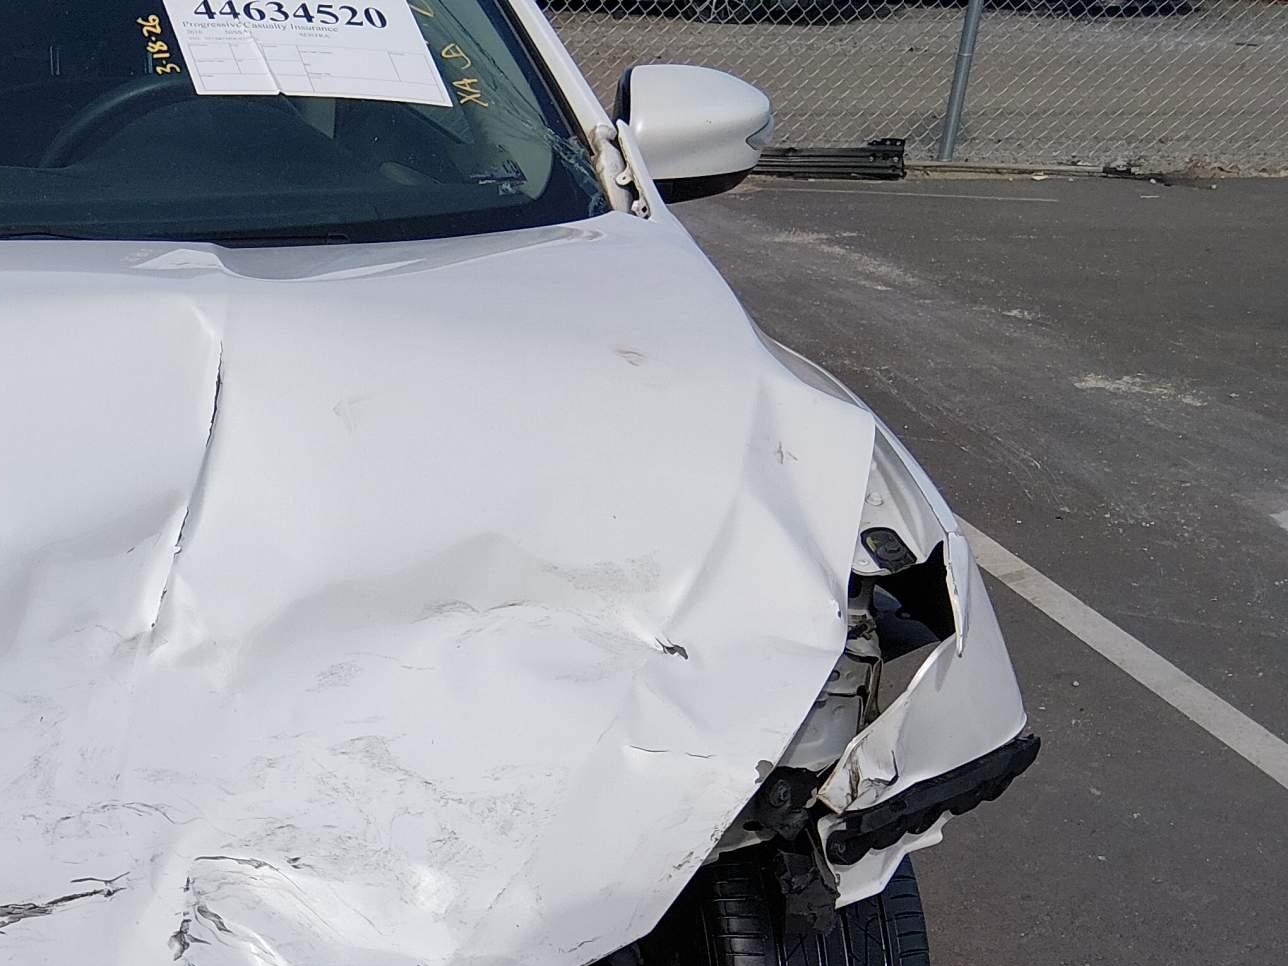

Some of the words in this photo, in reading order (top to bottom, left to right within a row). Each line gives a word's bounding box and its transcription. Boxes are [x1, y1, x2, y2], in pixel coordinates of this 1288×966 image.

[194, 0, 387, 29] 44634520
[182, 20, 241, 29] Progressive
[243, 22, 287, 31] Casualty
[290, 23, 338, 33] Insurance
